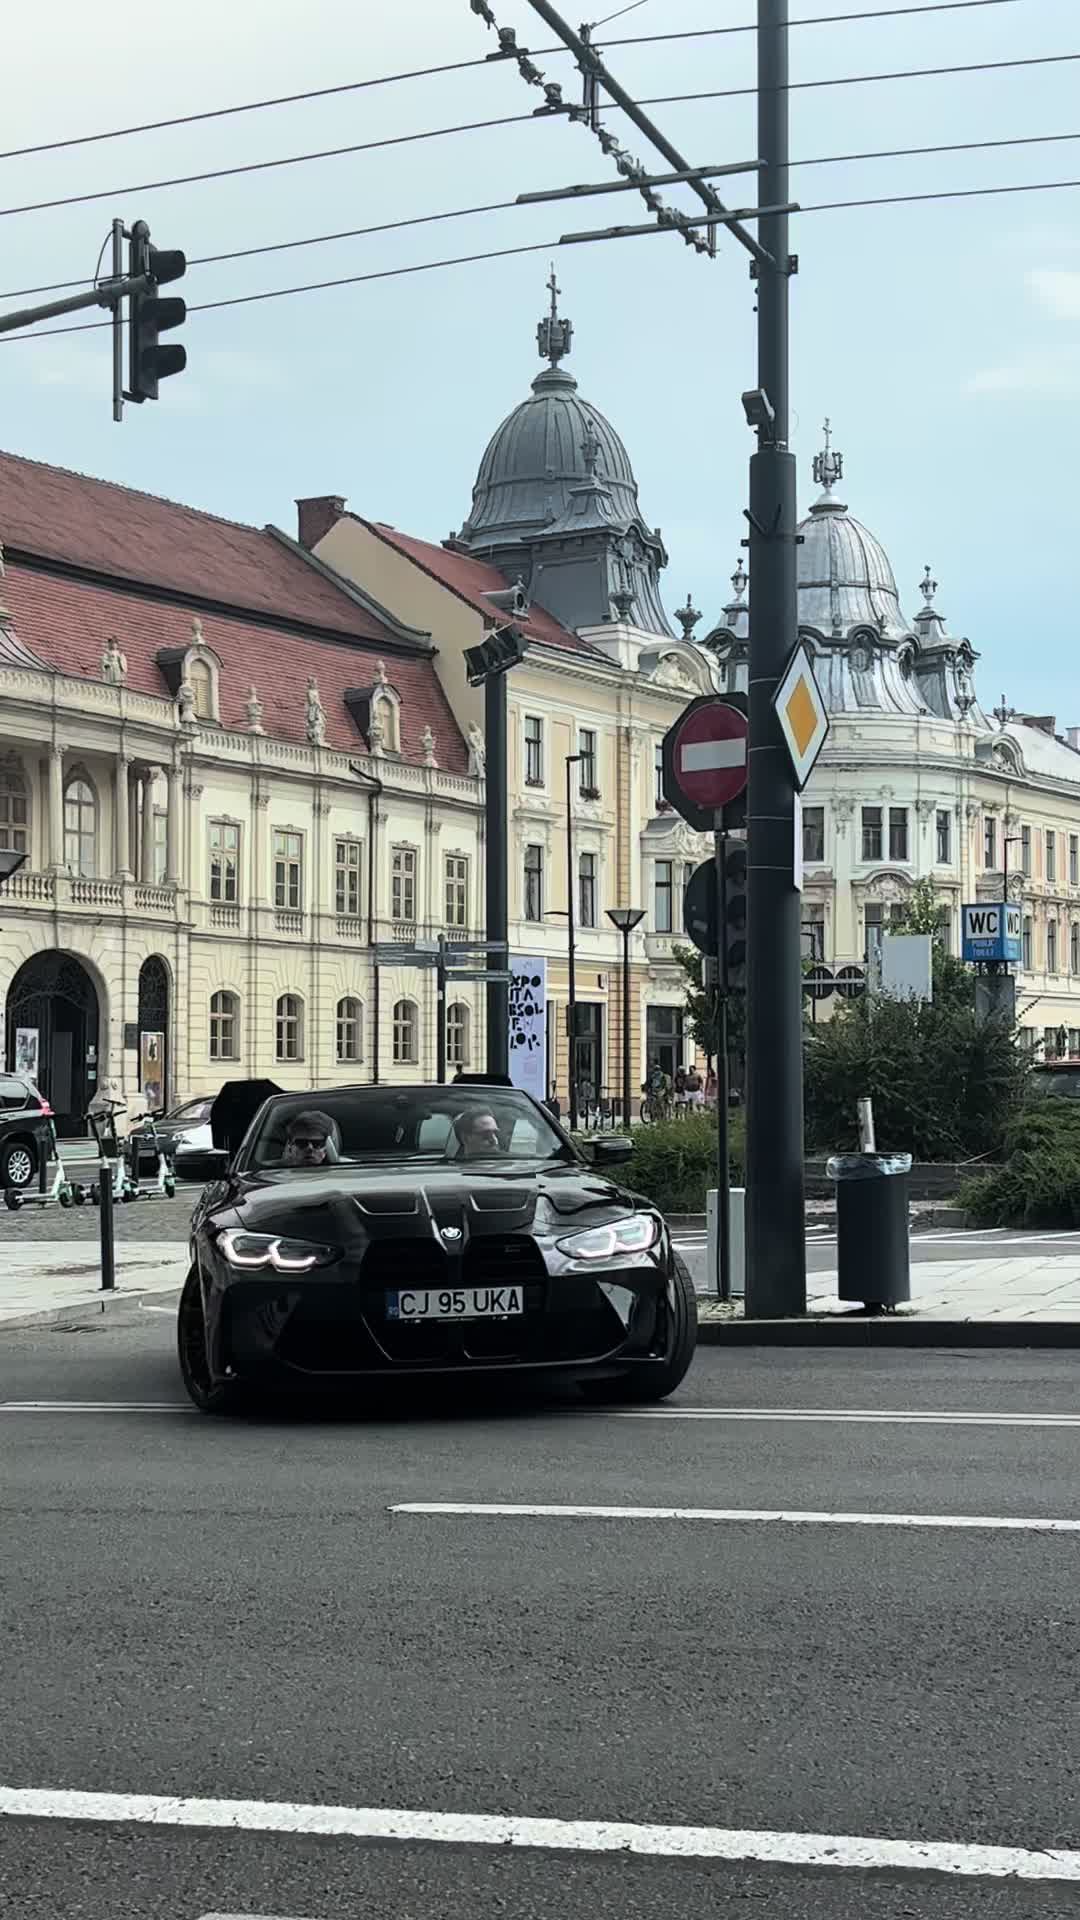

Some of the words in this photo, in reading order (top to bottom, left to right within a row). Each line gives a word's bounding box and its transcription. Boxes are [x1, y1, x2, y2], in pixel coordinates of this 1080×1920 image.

[969, 912, 998, 933] WC
[1007, 912, 1019, 934] WC
[510, 975, 541, 987] XPO
[401, 1293, 429, 1315] CJ
[438, 1290, 466, 1313] 95
[473, 1289, 520, 1312] UKA
